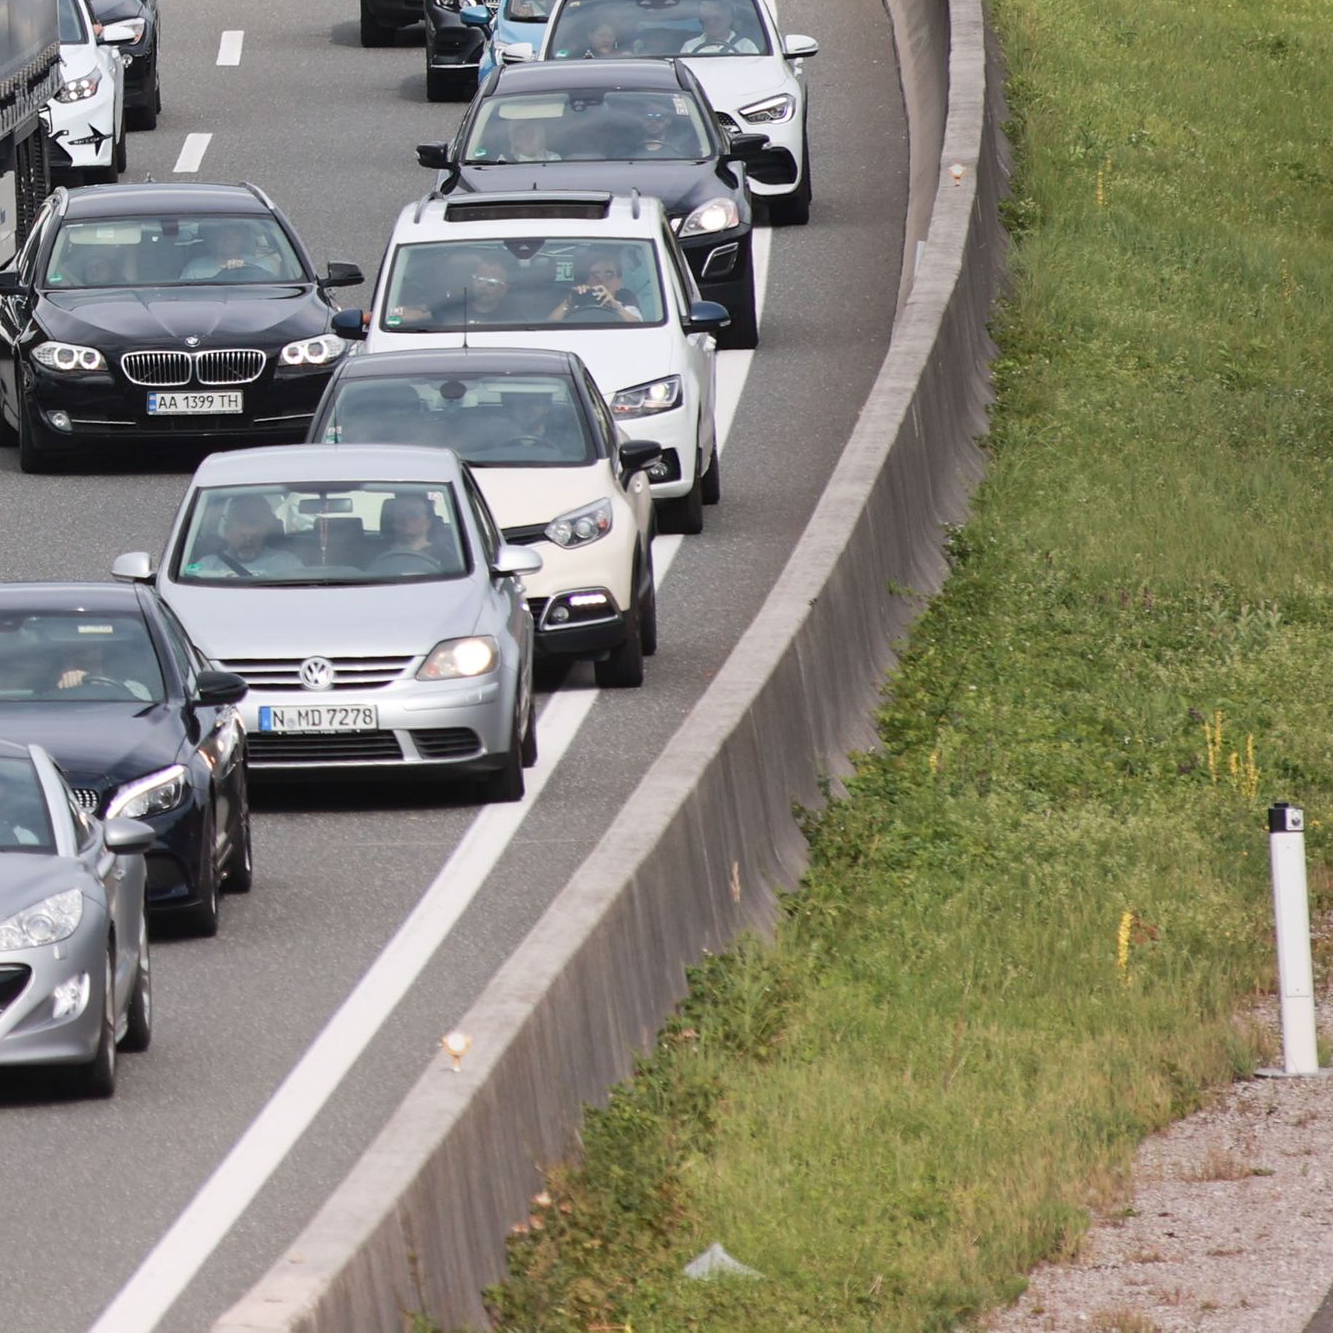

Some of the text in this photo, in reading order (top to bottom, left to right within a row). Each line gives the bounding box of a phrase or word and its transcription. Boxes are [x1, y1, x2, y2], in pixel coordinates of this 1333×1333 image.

[158, 394, 238, 409] AA 1399 TH
[273, 708, 373, 727] N MD 7278
